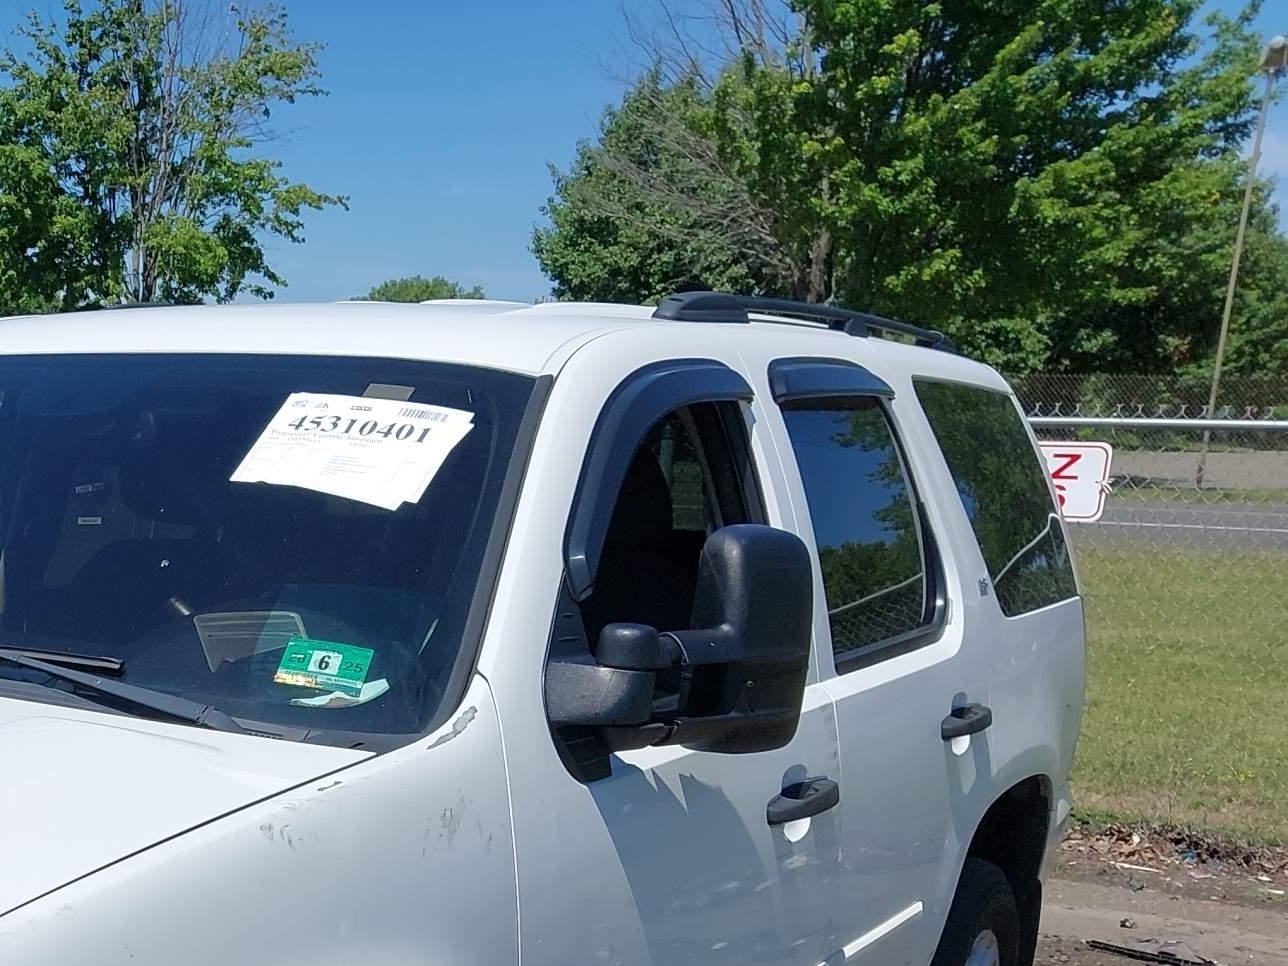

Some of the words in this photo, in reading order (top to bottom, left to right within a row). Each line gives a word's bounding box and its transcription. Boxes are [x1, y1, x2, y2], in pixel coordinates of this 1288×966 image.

[288, 415, 432, 443] 45310401
[318, 654, 332, 671] 6
[343, 660, 364, 673] 25
